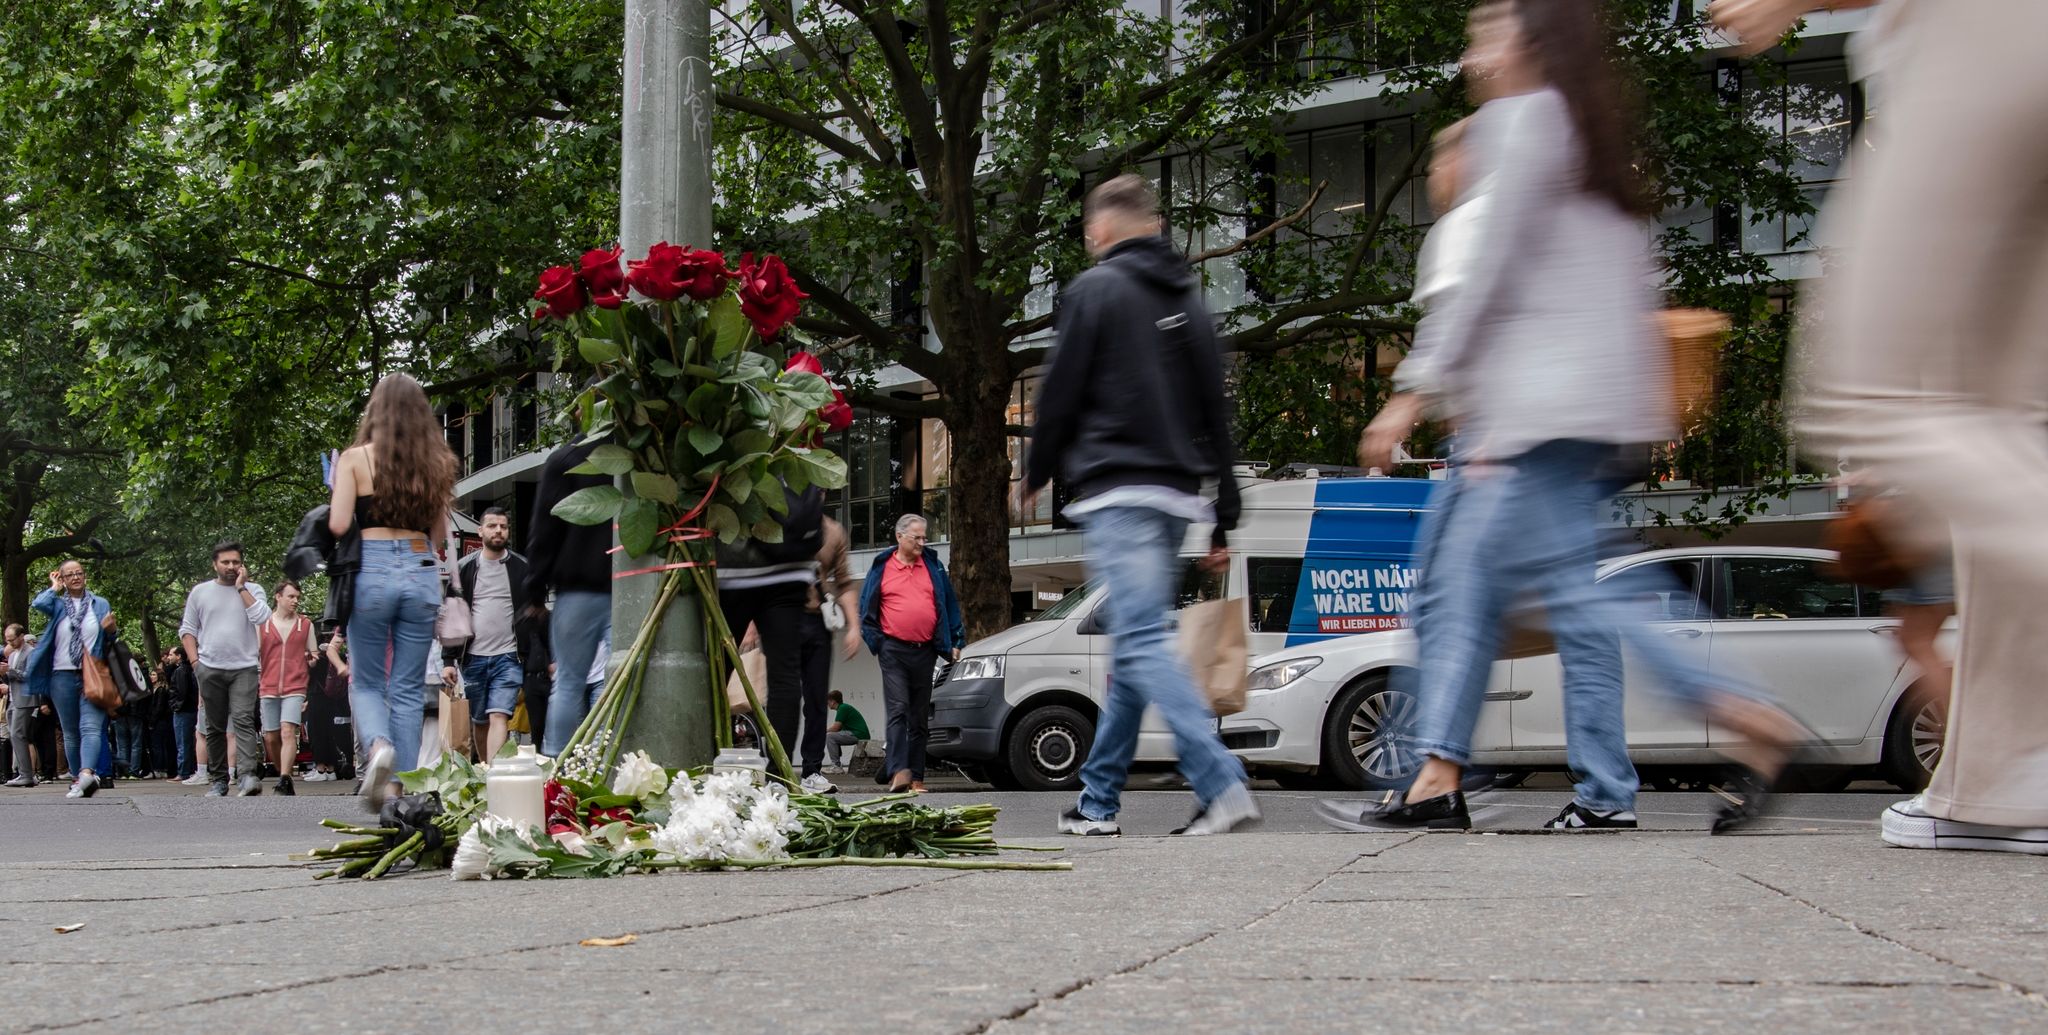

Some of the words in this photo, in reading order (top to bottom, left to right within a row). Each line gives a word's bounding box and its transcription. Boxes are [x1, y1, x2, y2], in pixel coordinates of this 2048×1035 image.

[1311, 569, 1369, 589] NOCH
[1313, 589, 1374, 614] WÄRE
[1321, 620, 1340, 630] WIR
[1342, 618, 1377, 630] LIEBEN
[1378, 618, 1398, 629] DAS
